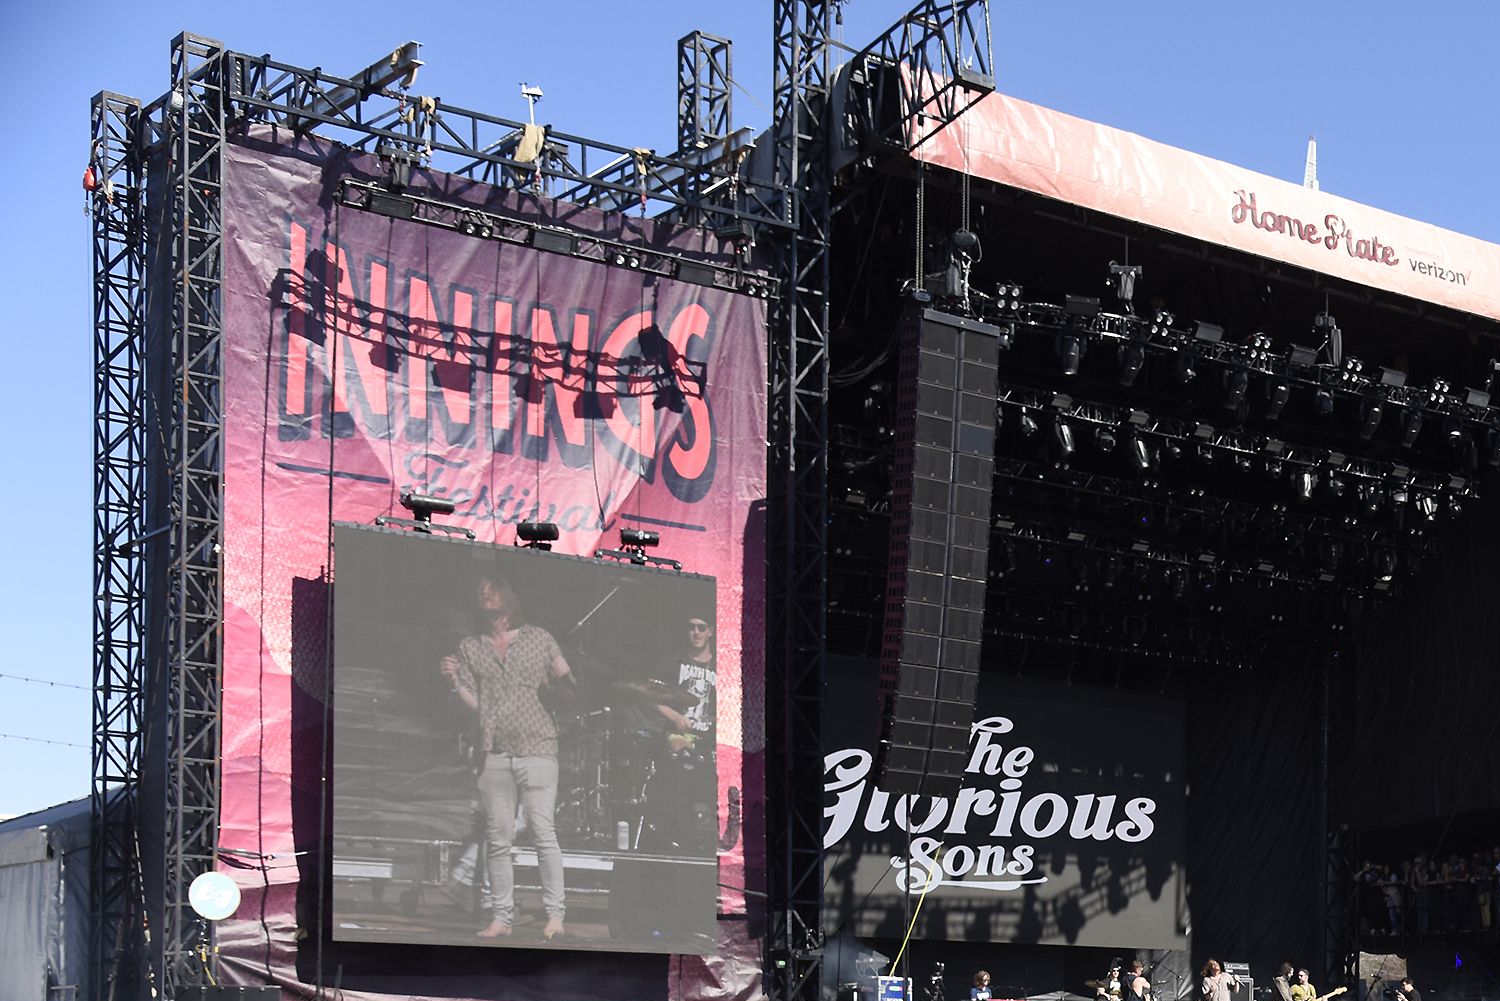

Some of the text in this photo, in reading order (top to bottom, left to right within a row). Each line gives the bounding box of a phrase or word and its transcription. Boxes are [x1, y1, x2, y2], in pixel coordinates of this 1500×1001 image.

[1231, 189, 1399, 266] Home Plate
[1408, 259, 1466, 286] verizon
[279, 218, 716, 504] INNINGS
[889, 836, 1036, 895] Sons
